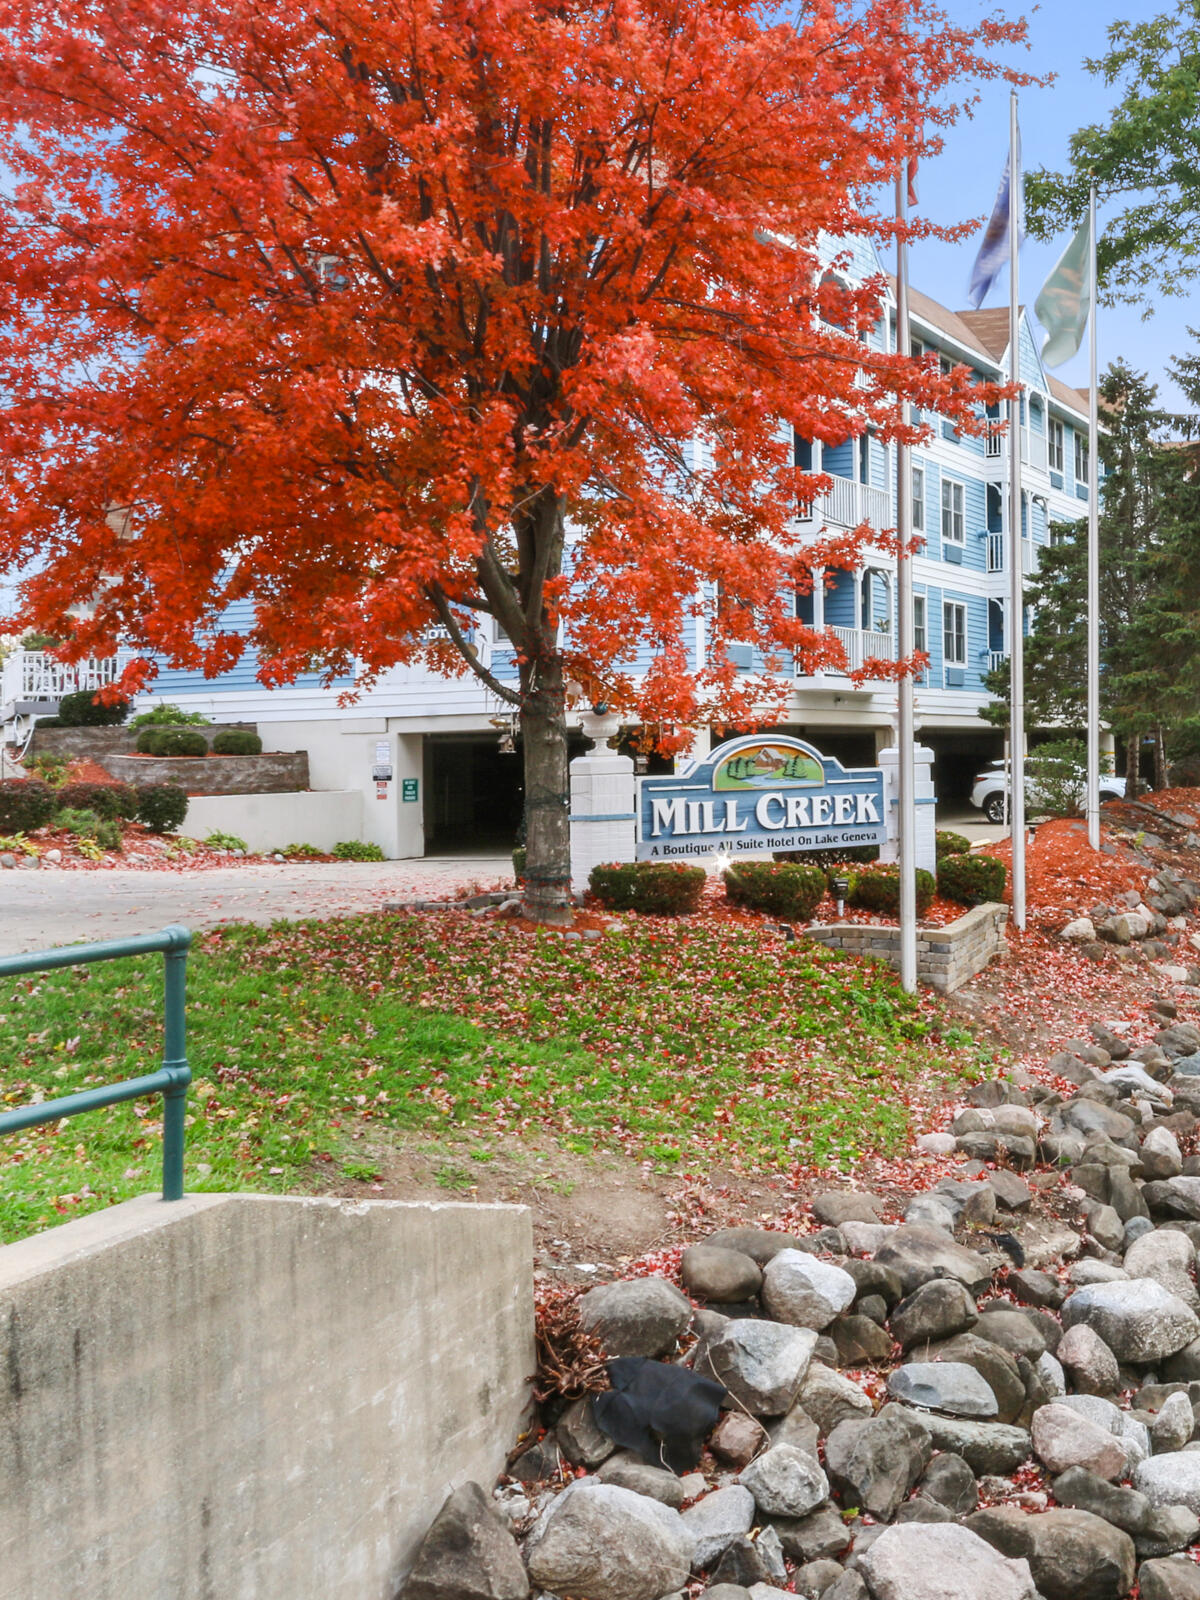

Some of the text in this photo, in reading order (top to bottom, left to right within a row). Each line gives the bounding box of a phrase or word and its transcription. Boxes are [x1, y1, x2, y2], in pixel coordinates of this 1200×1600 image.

[651, 792, 881, 837] MILL CREEK
[651, 832, 878, 856] A Boutique All Suite Hotel On Lake Geneva
